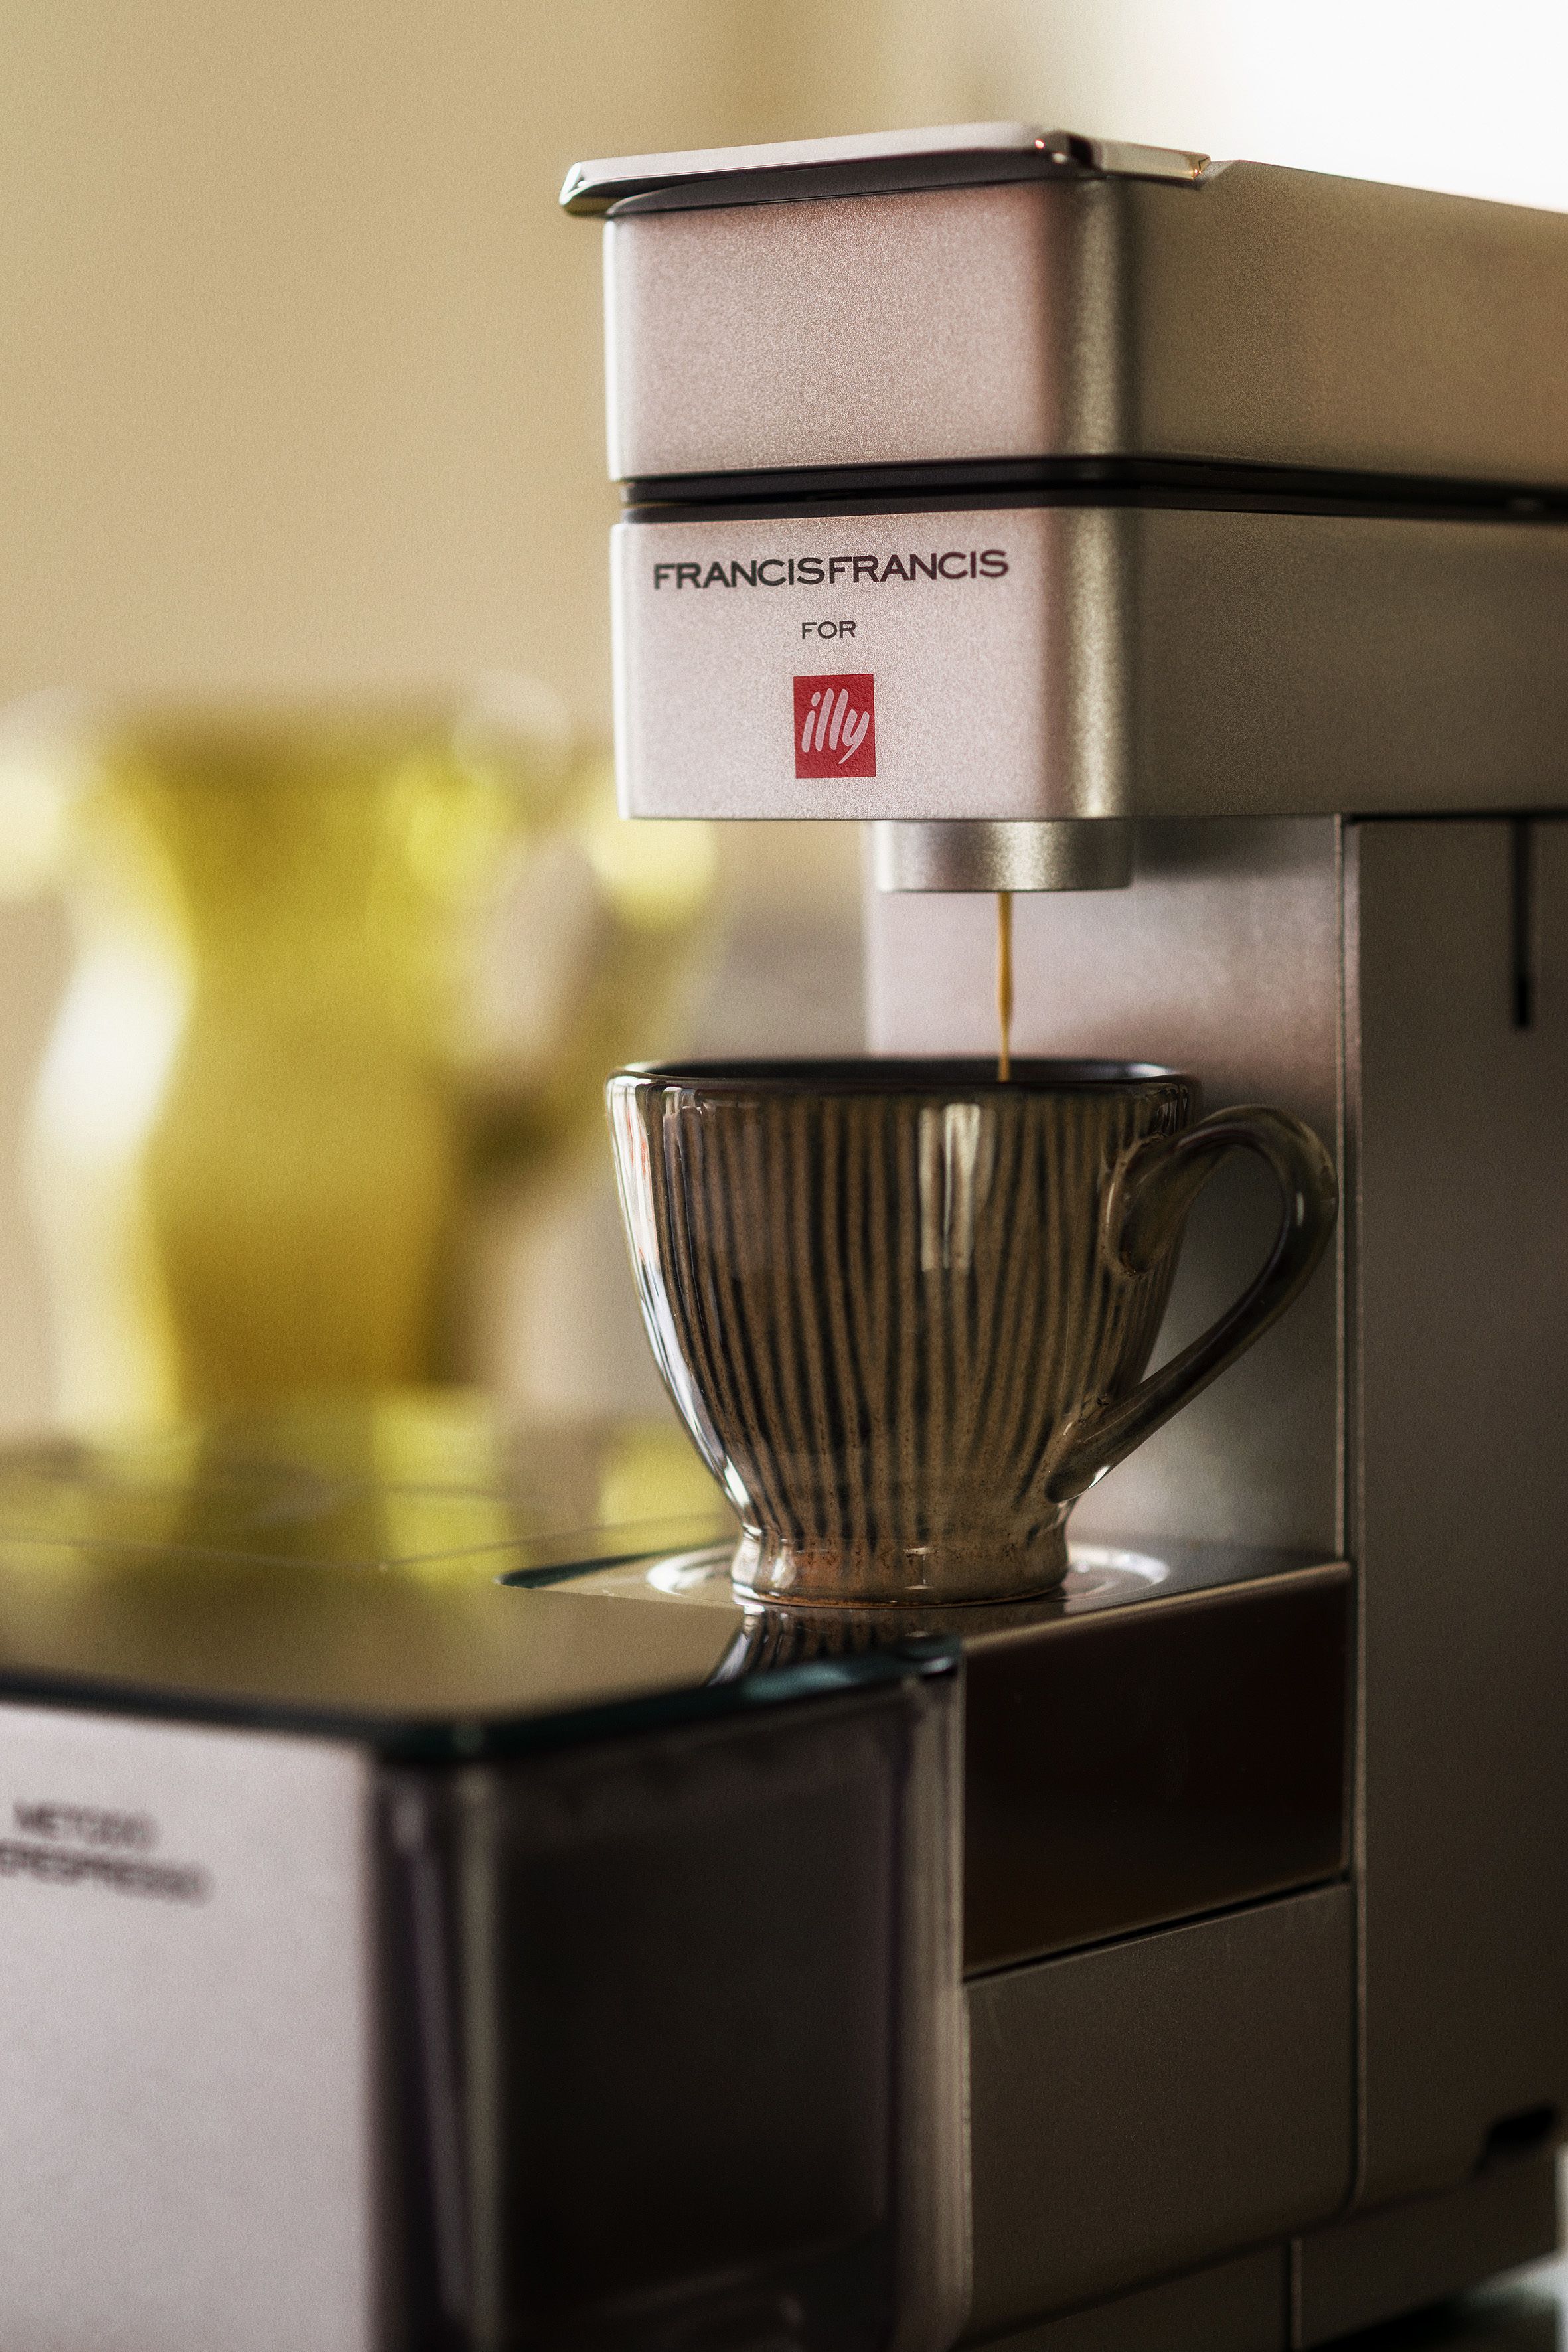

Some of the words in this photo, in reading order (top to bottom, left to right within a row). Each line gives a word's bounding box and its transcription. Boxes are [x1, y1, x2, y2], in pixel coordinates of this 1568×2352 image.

[653, 549, 1010, 589] FRANCISFRANCIS
[801, 621, 856, 639] FOR
[801, 688, 870, 764] illy
